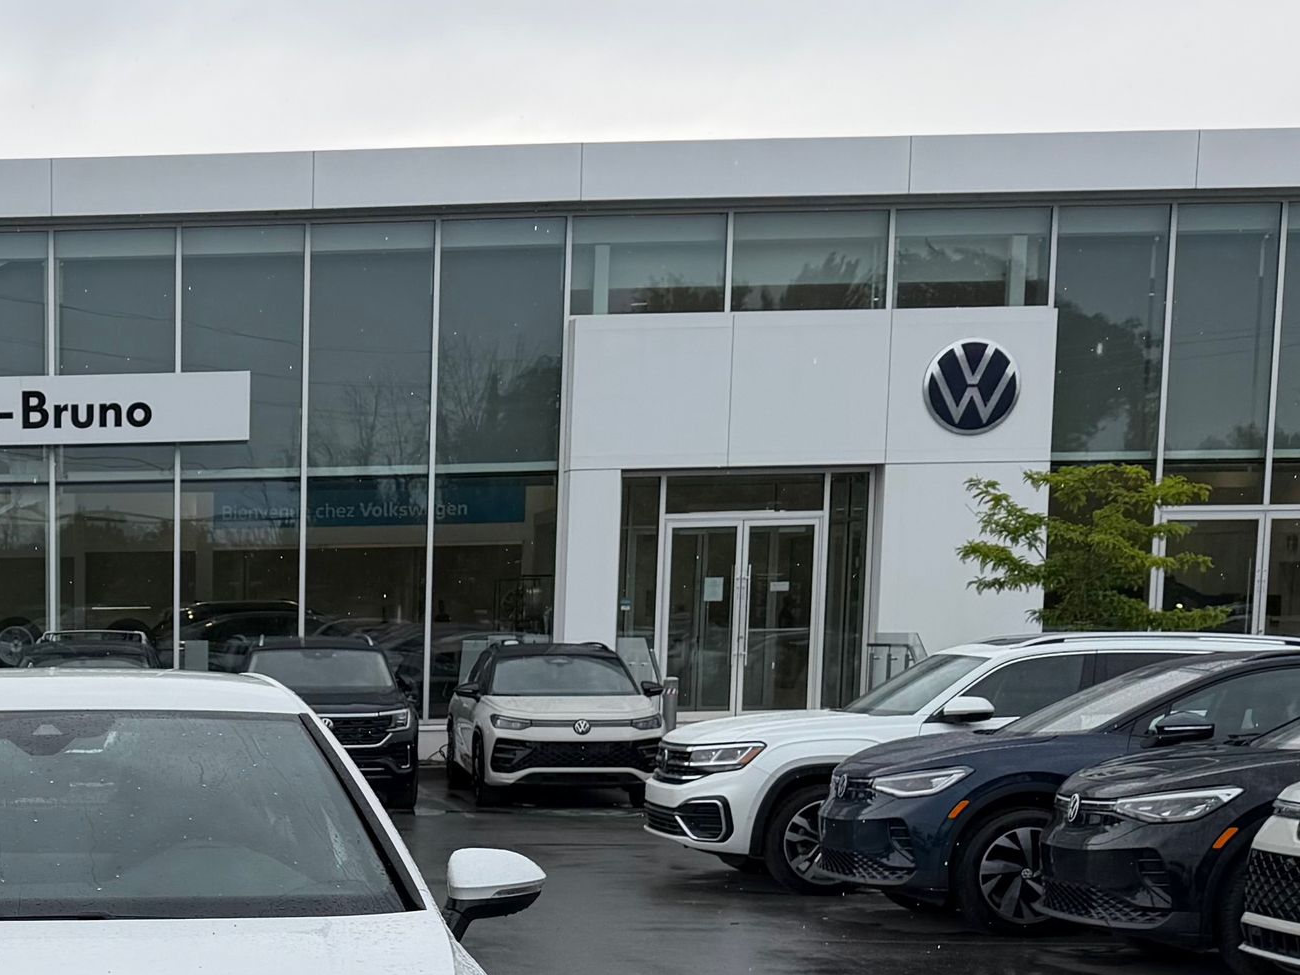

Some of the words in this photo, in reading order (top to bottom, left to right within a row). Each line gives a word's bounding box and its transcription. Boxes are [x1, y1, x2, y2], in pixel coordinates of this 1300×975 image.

[924, 338, 1019, 433] VW
[221, 504, 309, 520] Bienvenu
[315, 503, 355, 518] chez
[359, 501, 468, 520] Volkswgen
